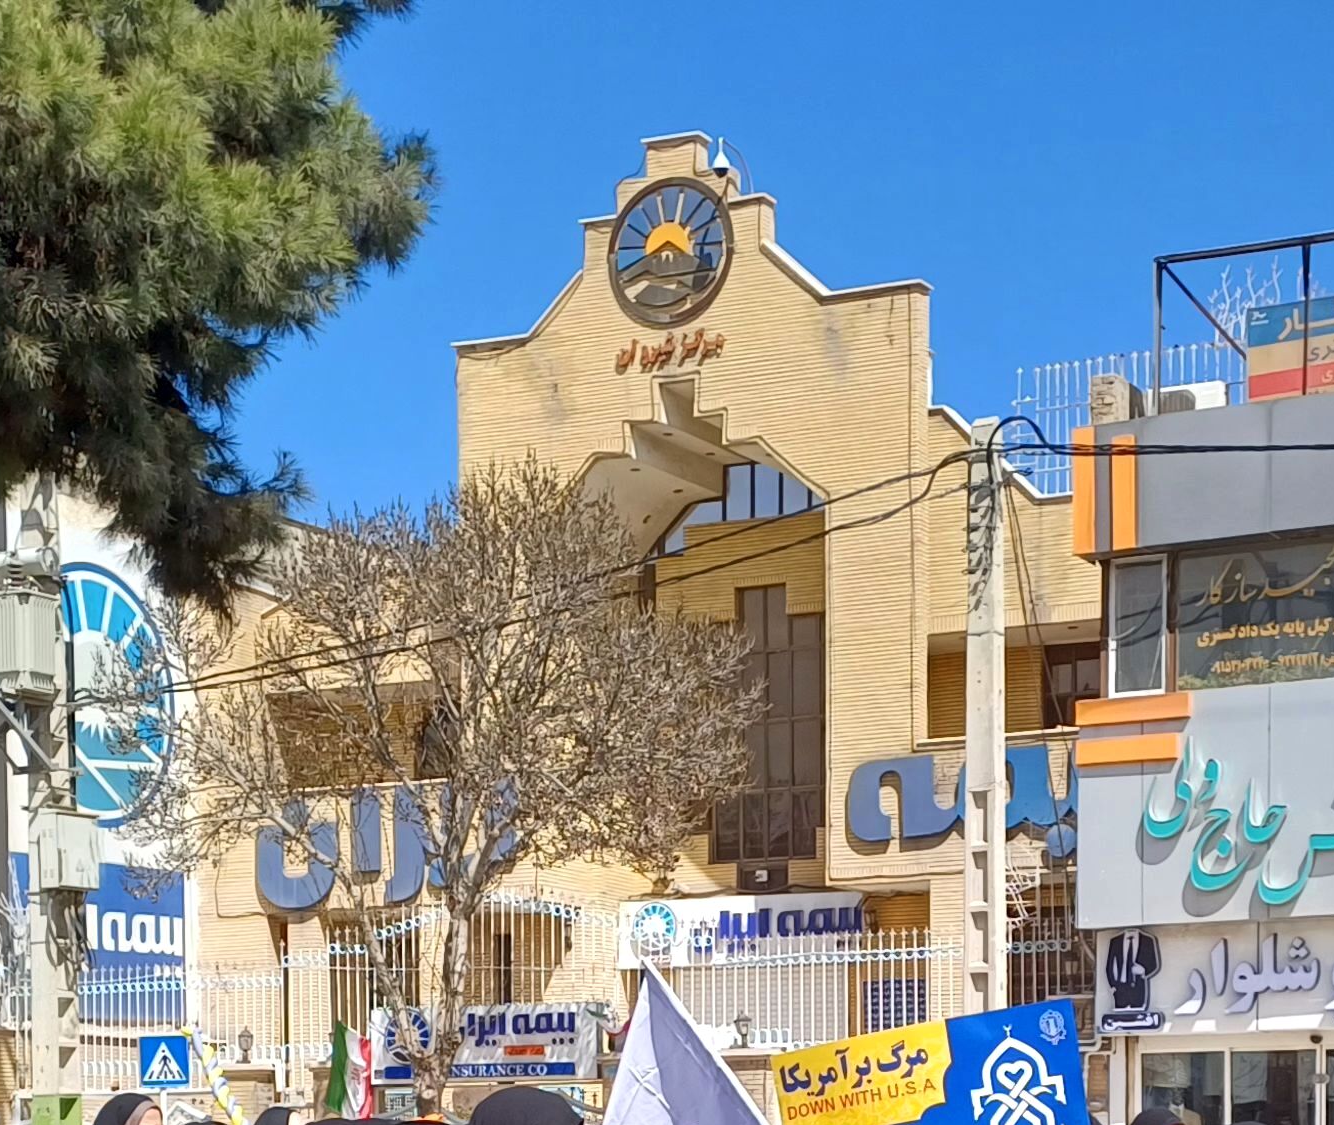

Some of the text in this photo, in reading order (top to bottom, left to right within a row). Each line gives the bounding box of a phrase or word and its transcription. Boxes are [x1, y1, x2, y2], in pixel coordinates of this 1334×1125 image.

[1260, 622, 1281, 640] یک
[1282, 620, 1307, 639] پایه
[1143, 736, 1222, 840] ولی
[1191, 777, 1289, 891] حاج
[1173, 933, 1321, 1015] شلوار
[460, 1011, 576, 1047] بیمه ایرا
[450, 1063, 548, 1079] NSURANCE CO
[779, 1040, 929, 1097] مرگ بر آمریکا
[787, 1078, 937, 1121] DOWN WITH U.S.A
